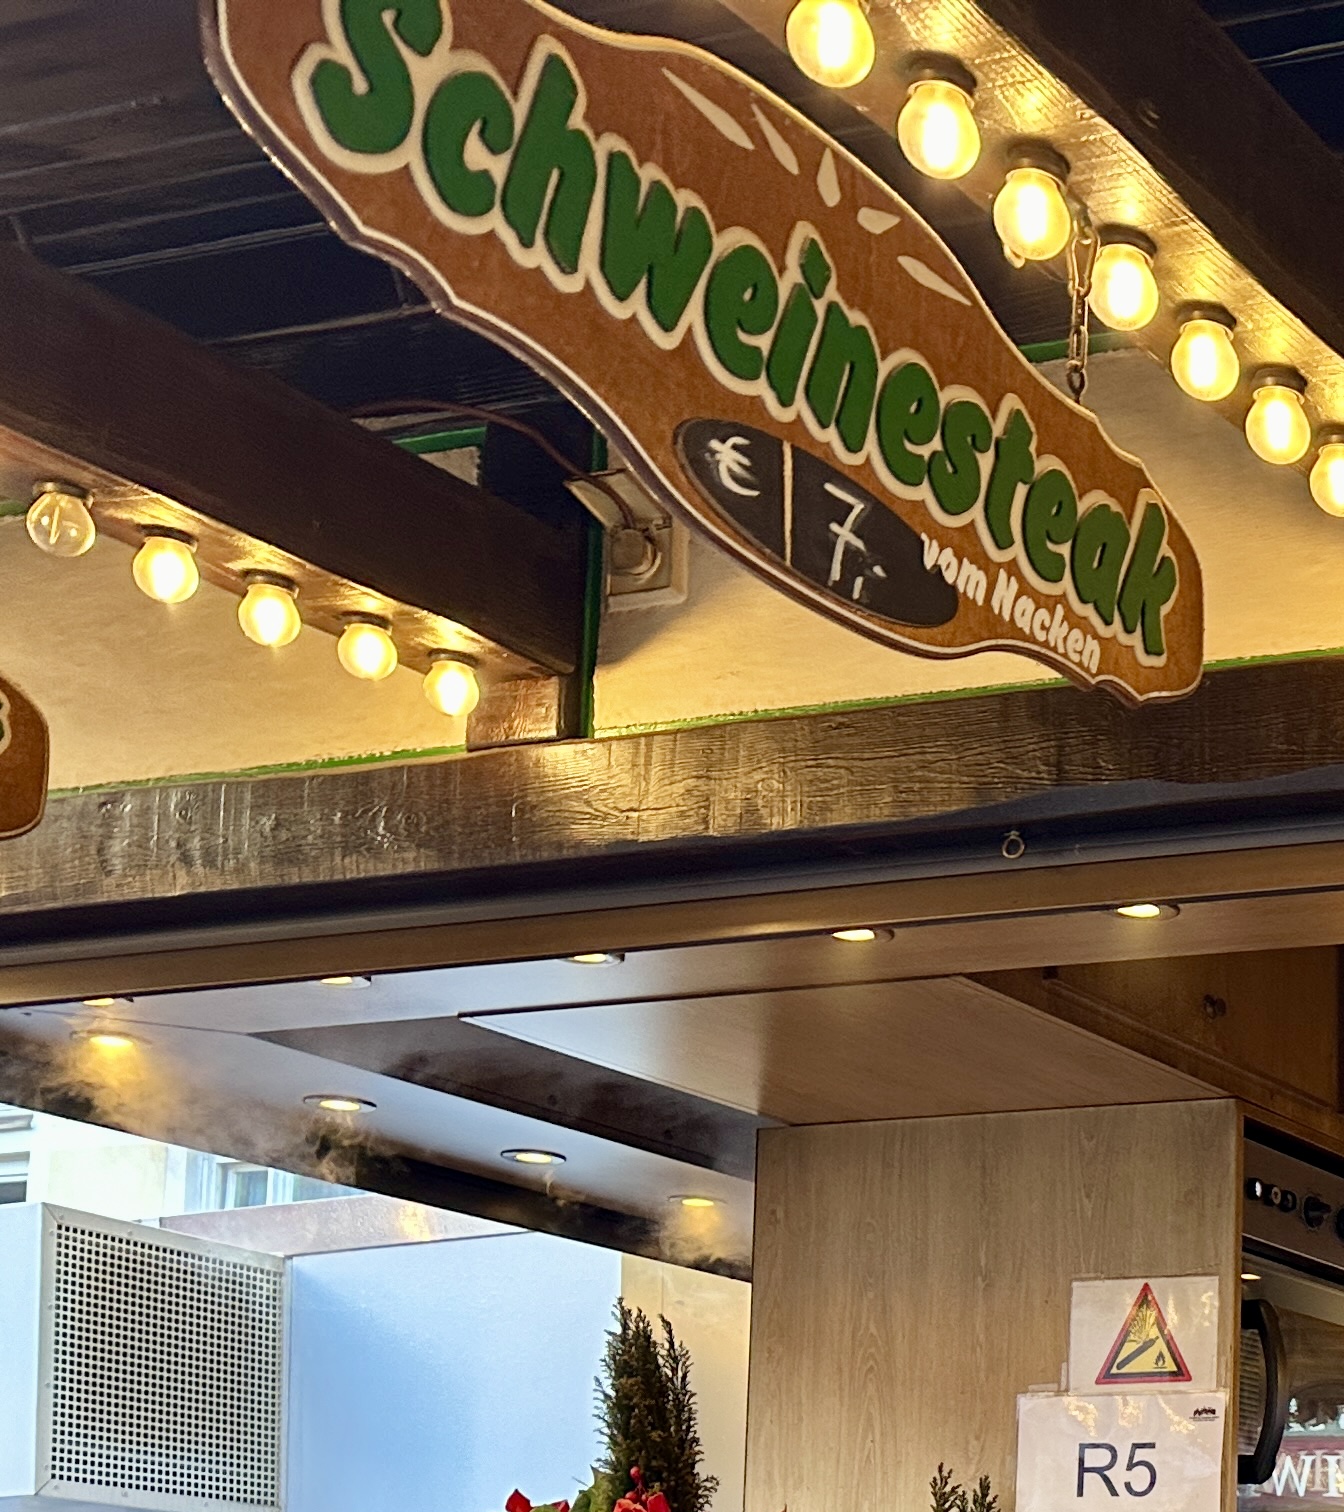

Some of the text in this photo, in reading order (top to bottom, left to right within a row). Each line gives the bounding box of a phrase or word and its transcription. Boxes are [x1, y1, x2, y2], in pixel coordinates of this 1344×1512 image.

[294, 0, 1180, 664] Schweinesteak
[920, 531, 1102, 676] vom Nacken
[1076, 1442, 1158, 1498] R5
